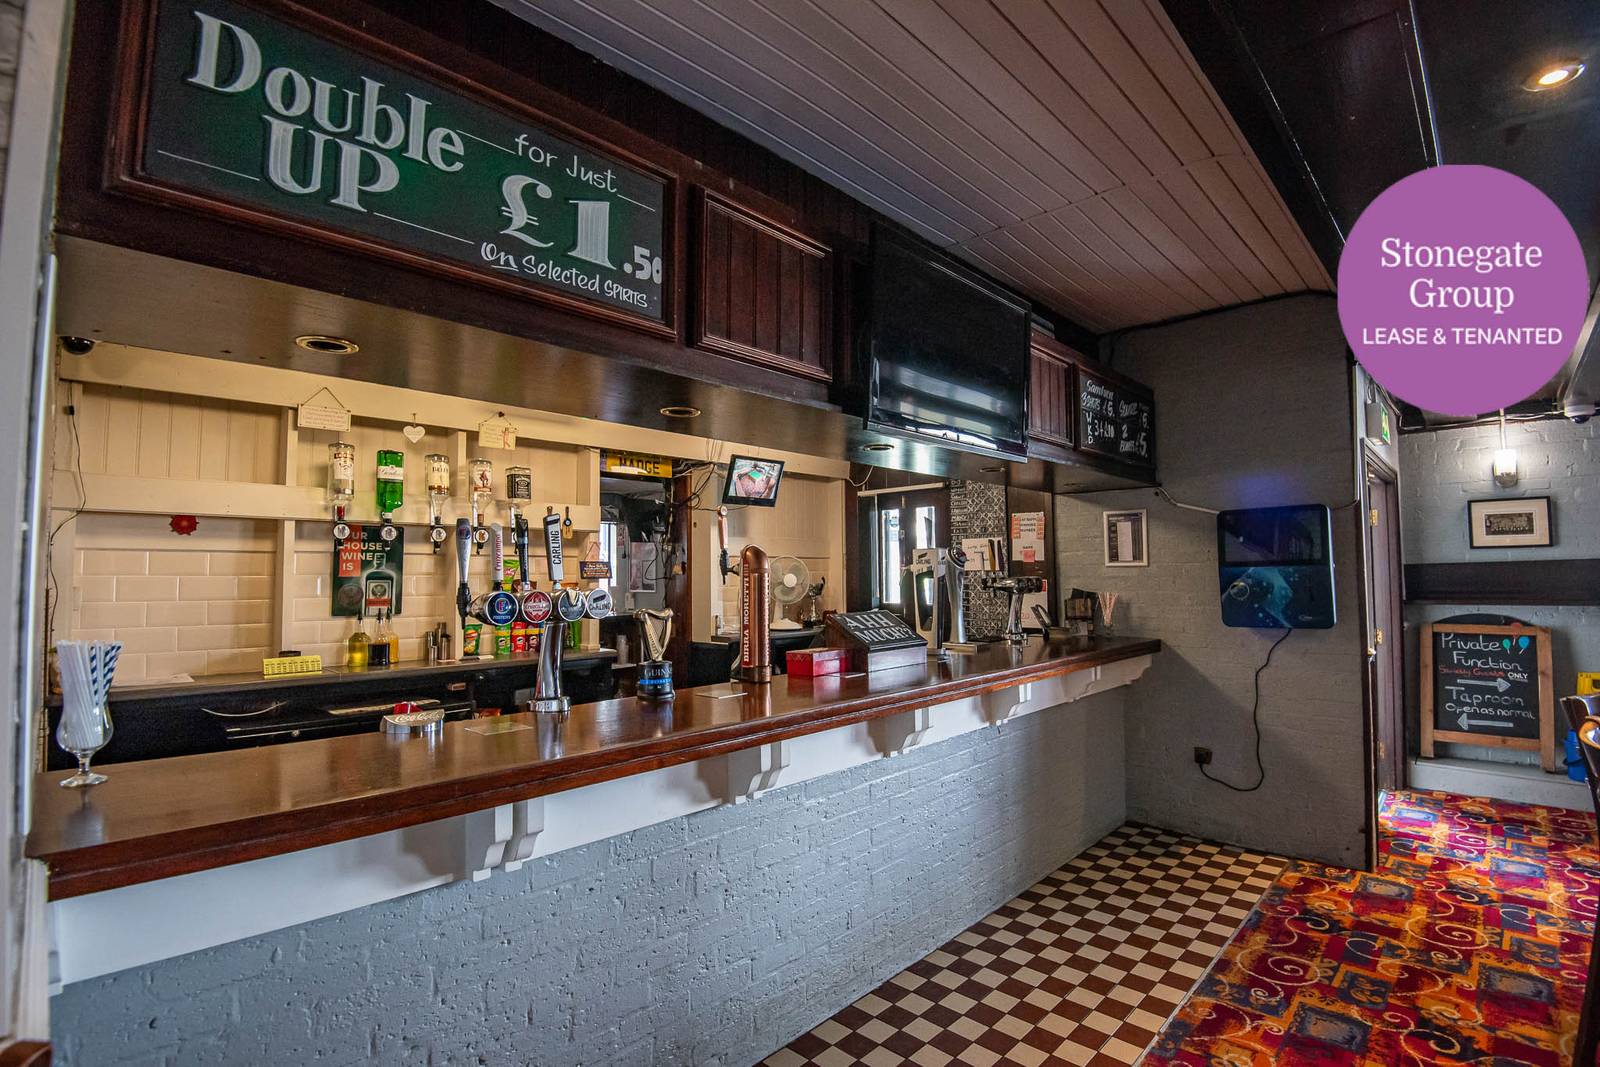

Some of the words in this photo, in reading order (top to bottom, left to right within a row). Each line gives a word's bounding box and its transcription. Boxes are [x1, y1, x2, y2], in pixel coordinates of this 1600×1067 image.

[187, 11, 465, 173] Double
[262, 114, 401, 213] UP
[514, 133, 557, 169] for
[565, 156, 618, 194] Just
[480, 241, 519, 271] On
[521, 254, 600, 294] Selected
[604, 279, 648, 308] SPIRITS
[343, 542, 383, 550] HOUSE
[550, 529, 562, 566] CARLING
[341, 552, 374, 561] WINE
[342, 562, 354, 571] IS
[1441, 633, 1502, 651] Private
[1453, 651, 1523, 671] Function
[1508, 671, 1529, 682] ONLY
